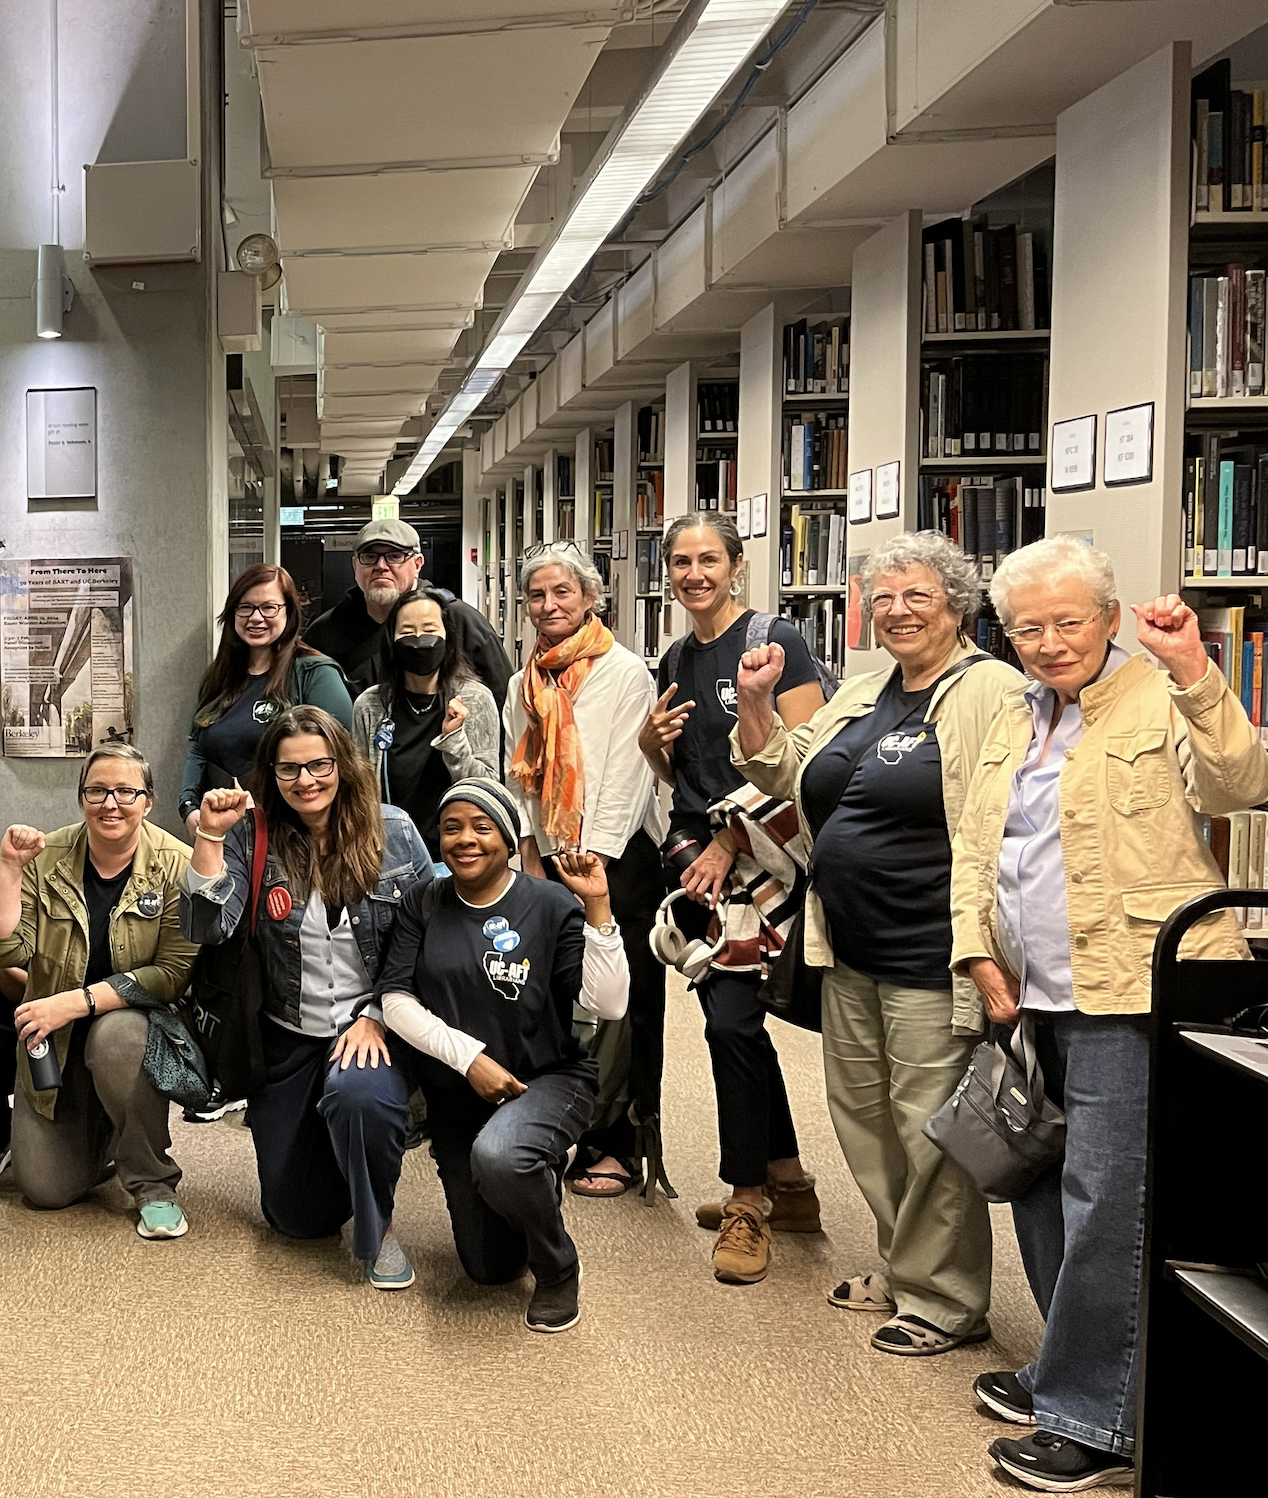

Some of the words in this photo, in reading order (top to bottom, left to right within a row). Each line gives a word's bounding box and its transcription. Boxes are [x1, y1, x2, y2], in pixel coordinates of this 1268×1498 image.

[378, 505, 395, 521] EXIT
[5, 728, 39, 740] Berkeley
[489, 960, 530, 981] UC-AFT
